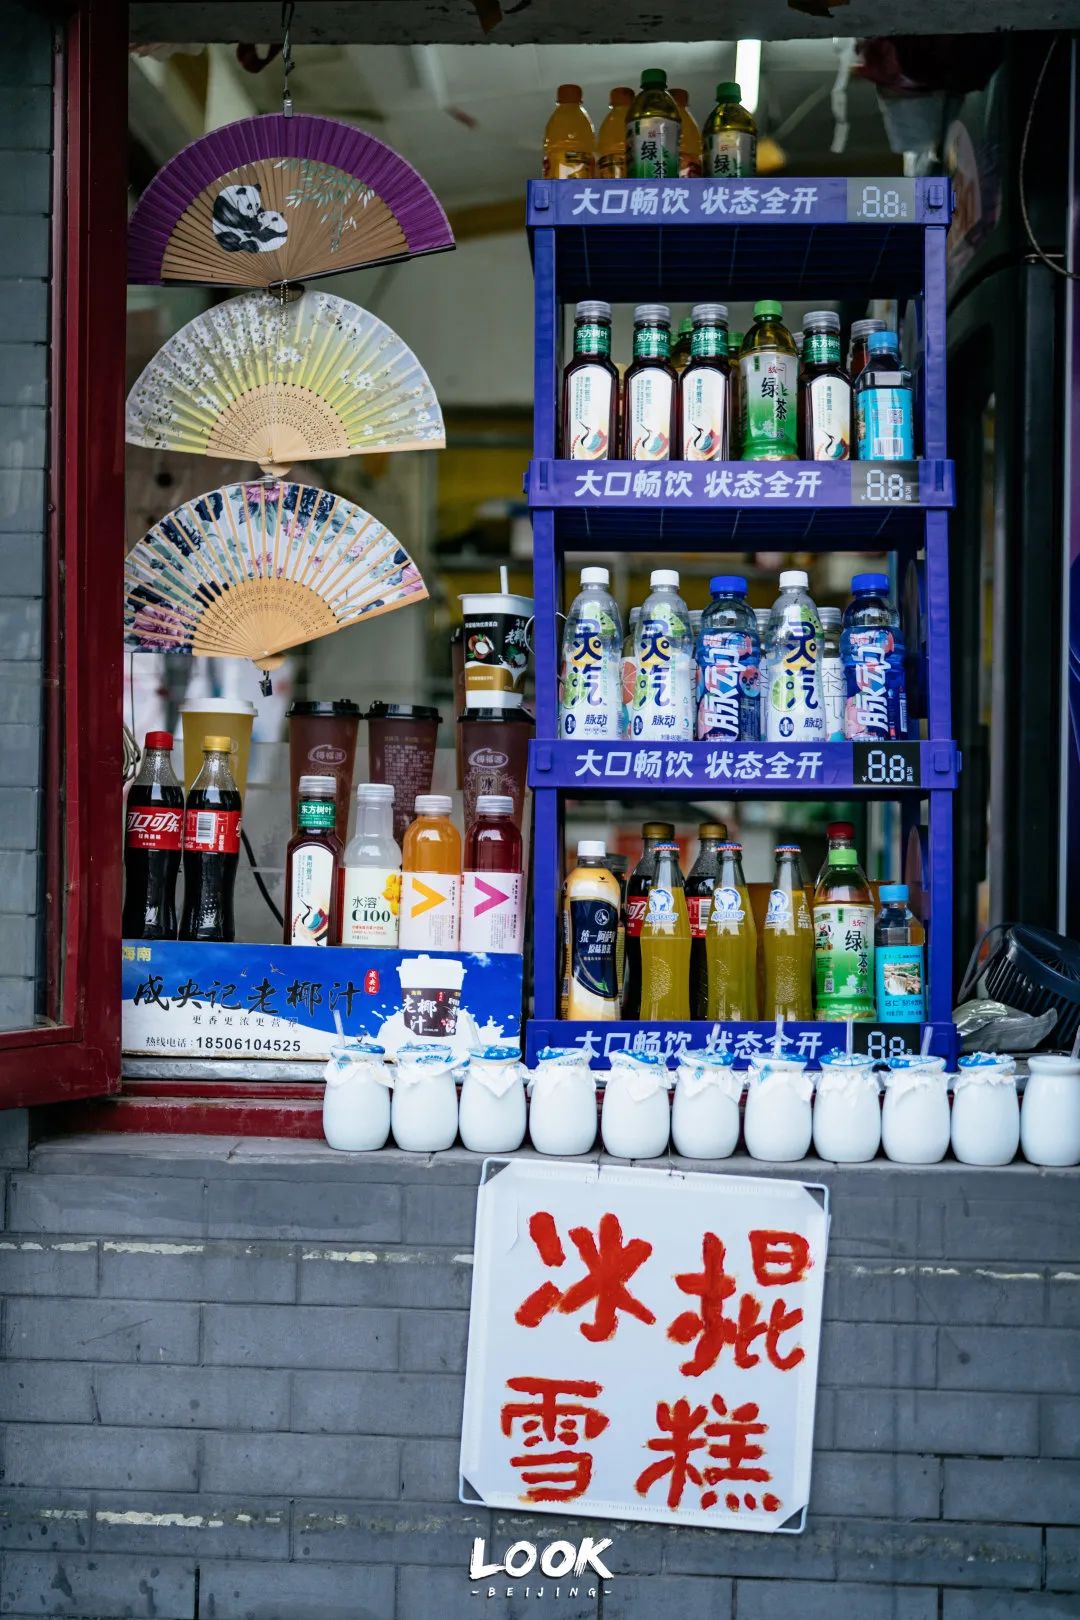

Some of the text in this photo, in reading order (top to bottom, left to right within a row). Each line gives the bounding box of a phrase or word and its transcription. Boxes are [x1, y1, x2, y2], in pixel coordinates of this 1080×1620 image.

[572, 187, 818, 215] 大口畅饮 状态全开
[574, 470, 822, 498] 大口畅饮 状态全开
[584, 714, 608, 727] 脉动
[651, 715, 676, 727] 脉动
[575, 749, 823, 779] 大口畅饮 状态全开
[301, 805, 332, 814] 东方树叶
[353, 896, 377, 908] 水溶
[352, 910, 391, 922] C100
[196, 1036, 301, 1052] 18506104525
[575, 1030, 692, 1058] 大口畅饮
[500, 1375, 783, 1513] 雪糕
